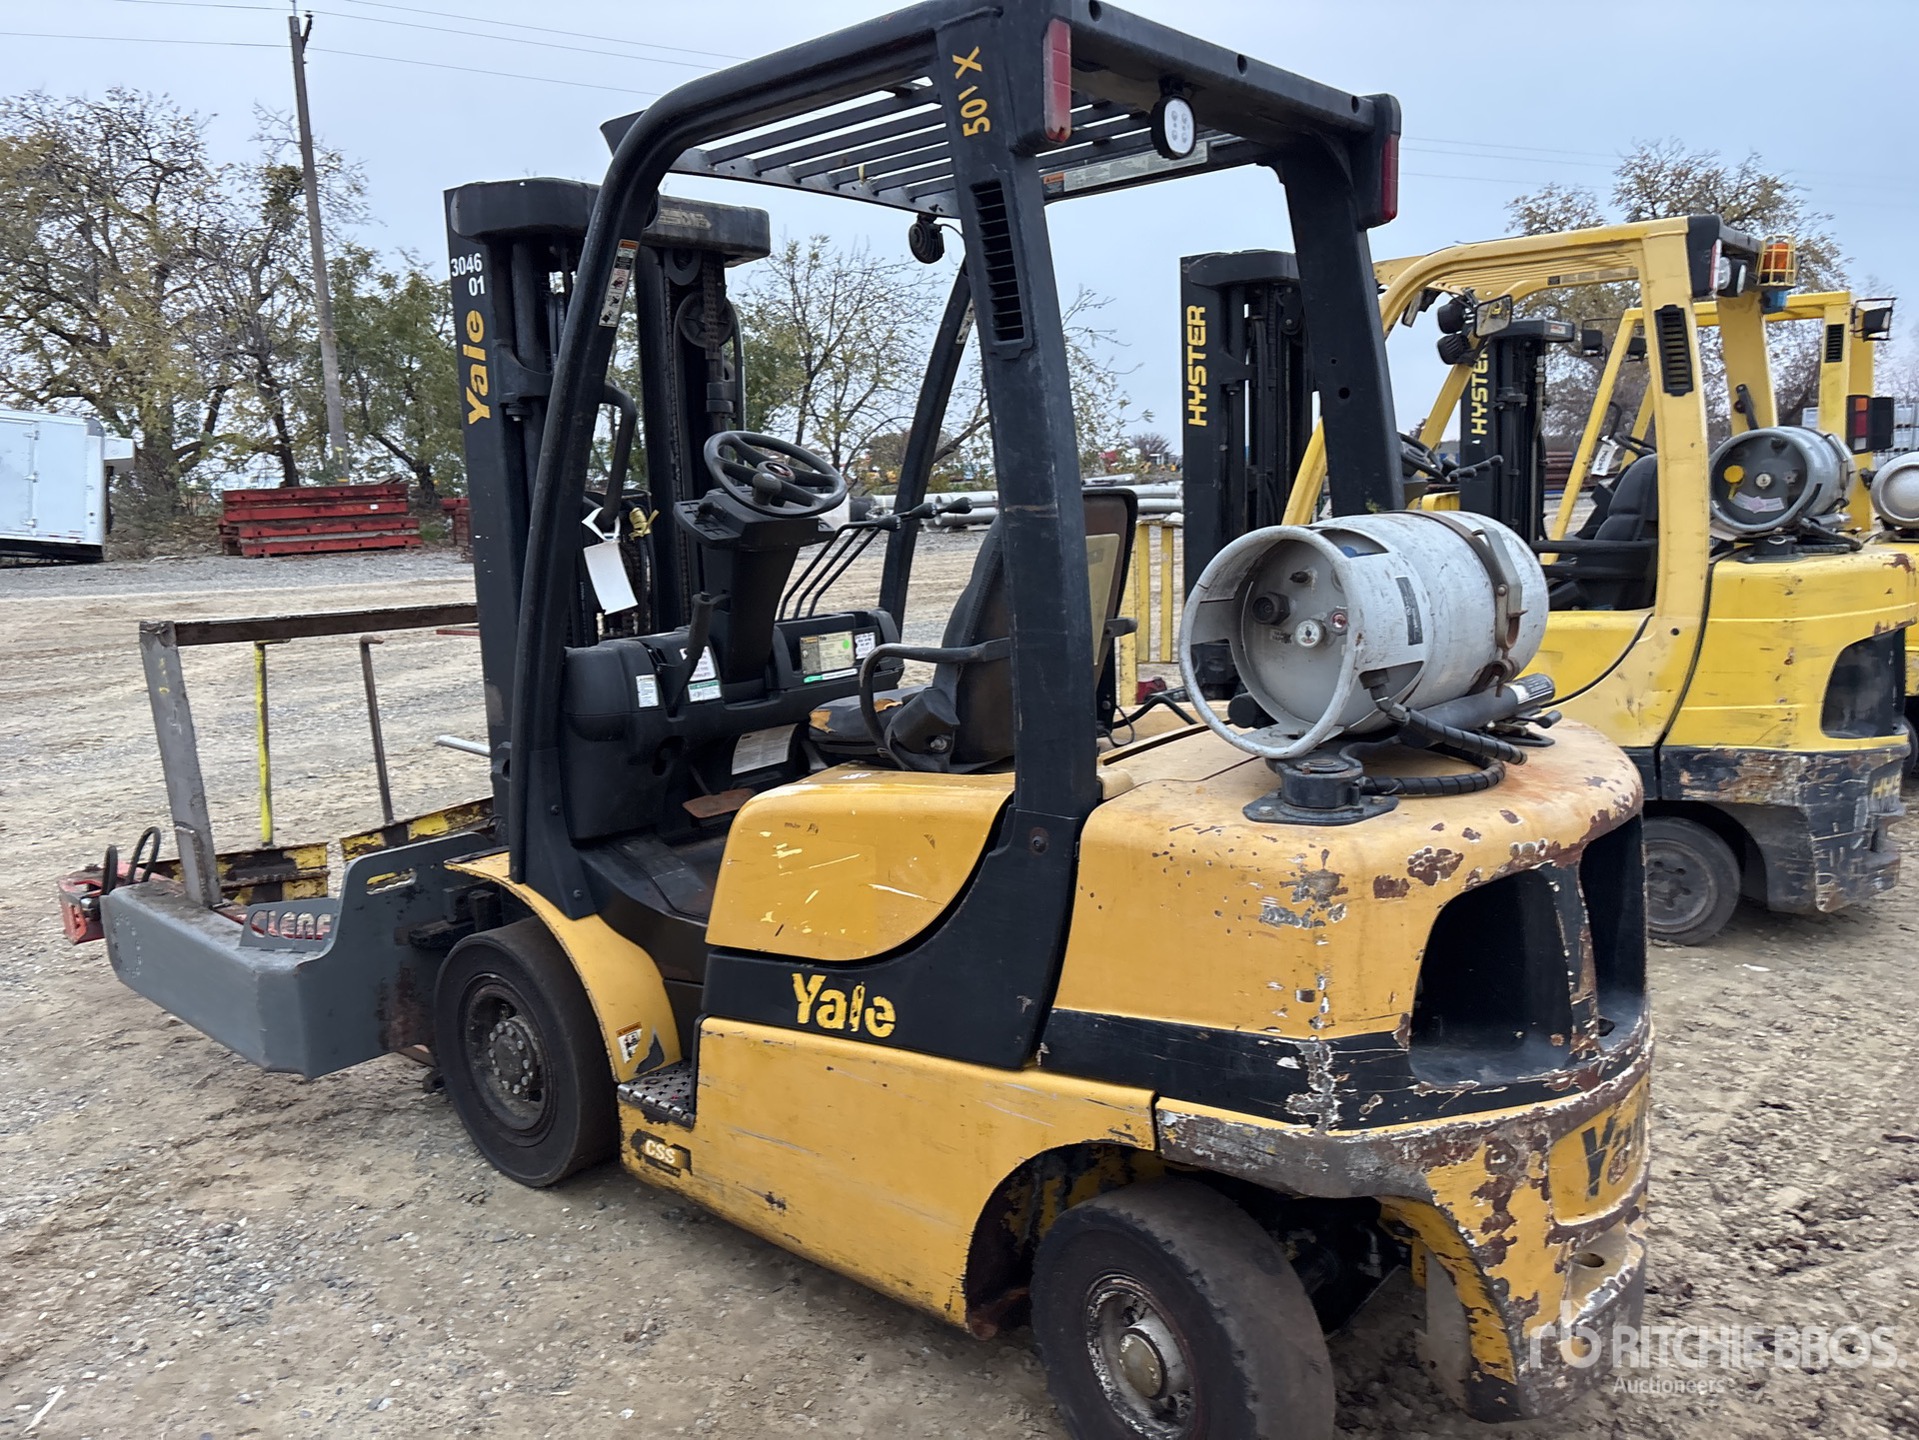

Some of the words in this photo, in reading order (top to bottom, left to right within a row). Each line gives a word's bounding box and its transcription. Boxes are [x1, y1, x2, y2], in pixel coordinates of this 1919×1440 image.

[451, 253, 482, 277] 3046
[468, 275, 485, 296] 01
[462, 310, 491, 425] Yale
[1186, 305, 1207, 426] HYSTER
[1471, 353, 1489, 435] HYSTE
[791, 972, 896, 1038] Yale
[645, 1139, 676, 1164] CSS
